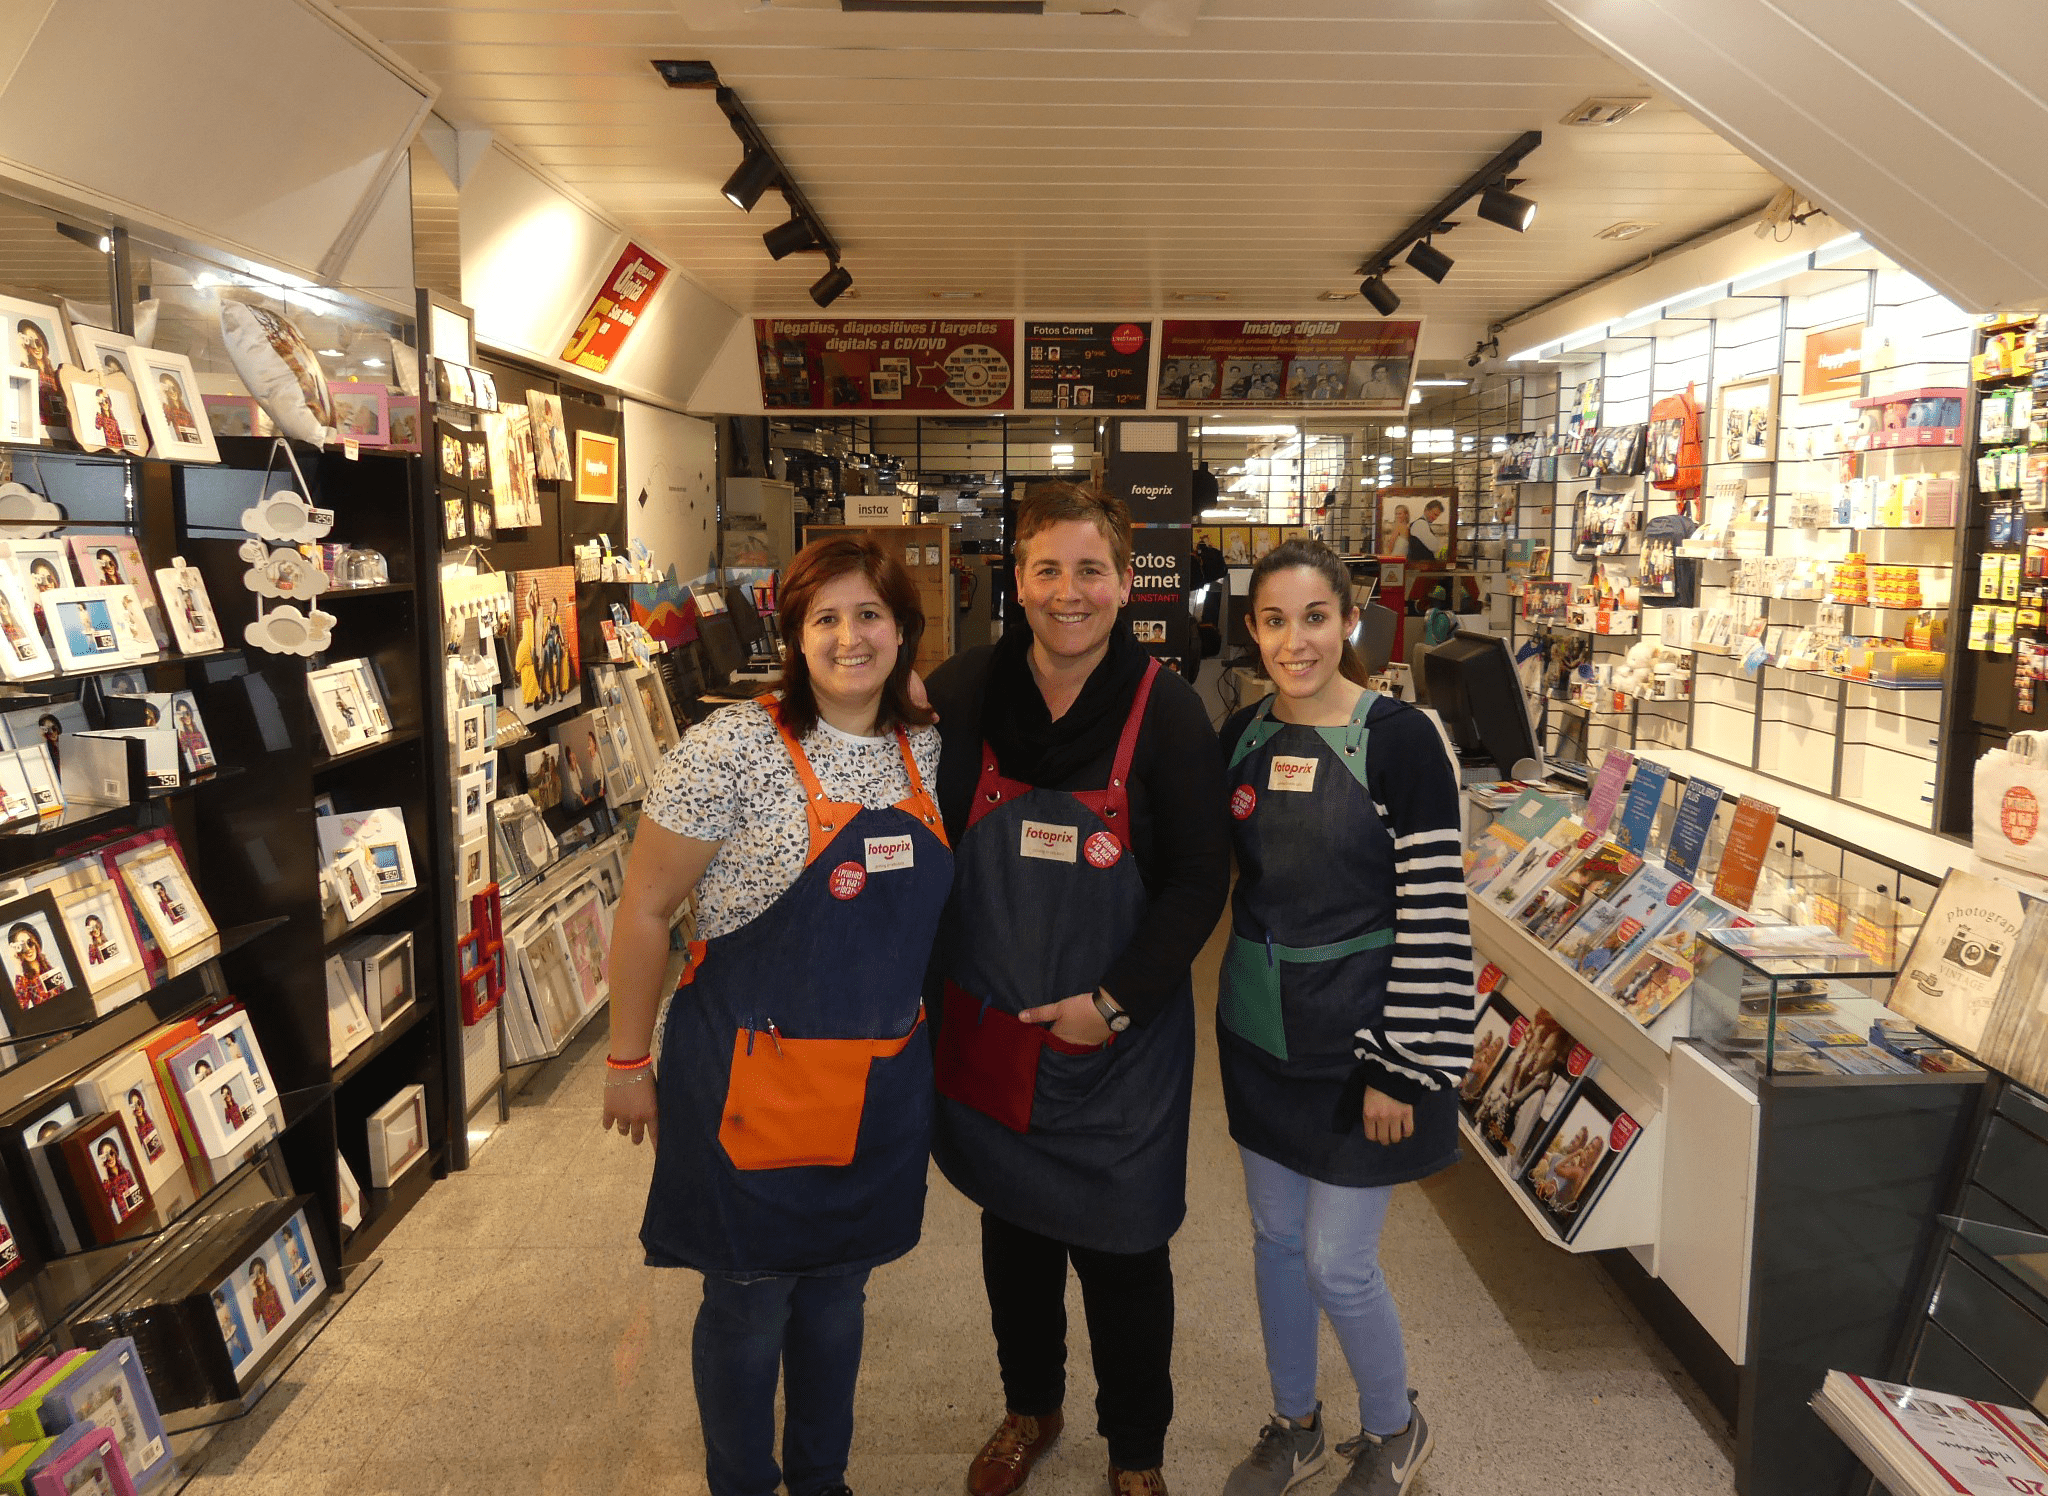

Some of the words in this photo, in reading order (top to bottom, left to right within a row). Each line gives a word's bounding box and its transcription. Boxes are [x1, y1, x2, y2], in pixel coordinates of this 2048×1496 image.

[562, 296, 614, 361] 5
[773, 321, 839, 336] Negatius,
[842, 321, 927, 336] diapositives
[931, 321, 937, 334] i
[940, 321, 998, 336] targetes
[1033, 326, 1060, 335] Fotos
[1062, 326, 1094, 335] Carnet
[1242, 321, 1292, 337] Imatge
[1294, 321, 1341, 337] digital
[825, 338, 878, 353] digitals
[881, 340, 890, 350] a
[894, 338, 947, 350] CD/DVD
[1131, 484, 1173, 496] fotoprix
[858, 503, 889, 515] instax
[1133, 573, 1181, 588] arnet
[1274, 761, 1313, 774] fotoprix
[1685, 789, 1701, 804] PLUS
[1688, 780, 1720, 801] FOTOLIBRO
[1026, 826, 1073, 843] fotoprix
[868, 840, 911, 856] fotoprix
[1939, 965, 1985, 991] VINTAGE
